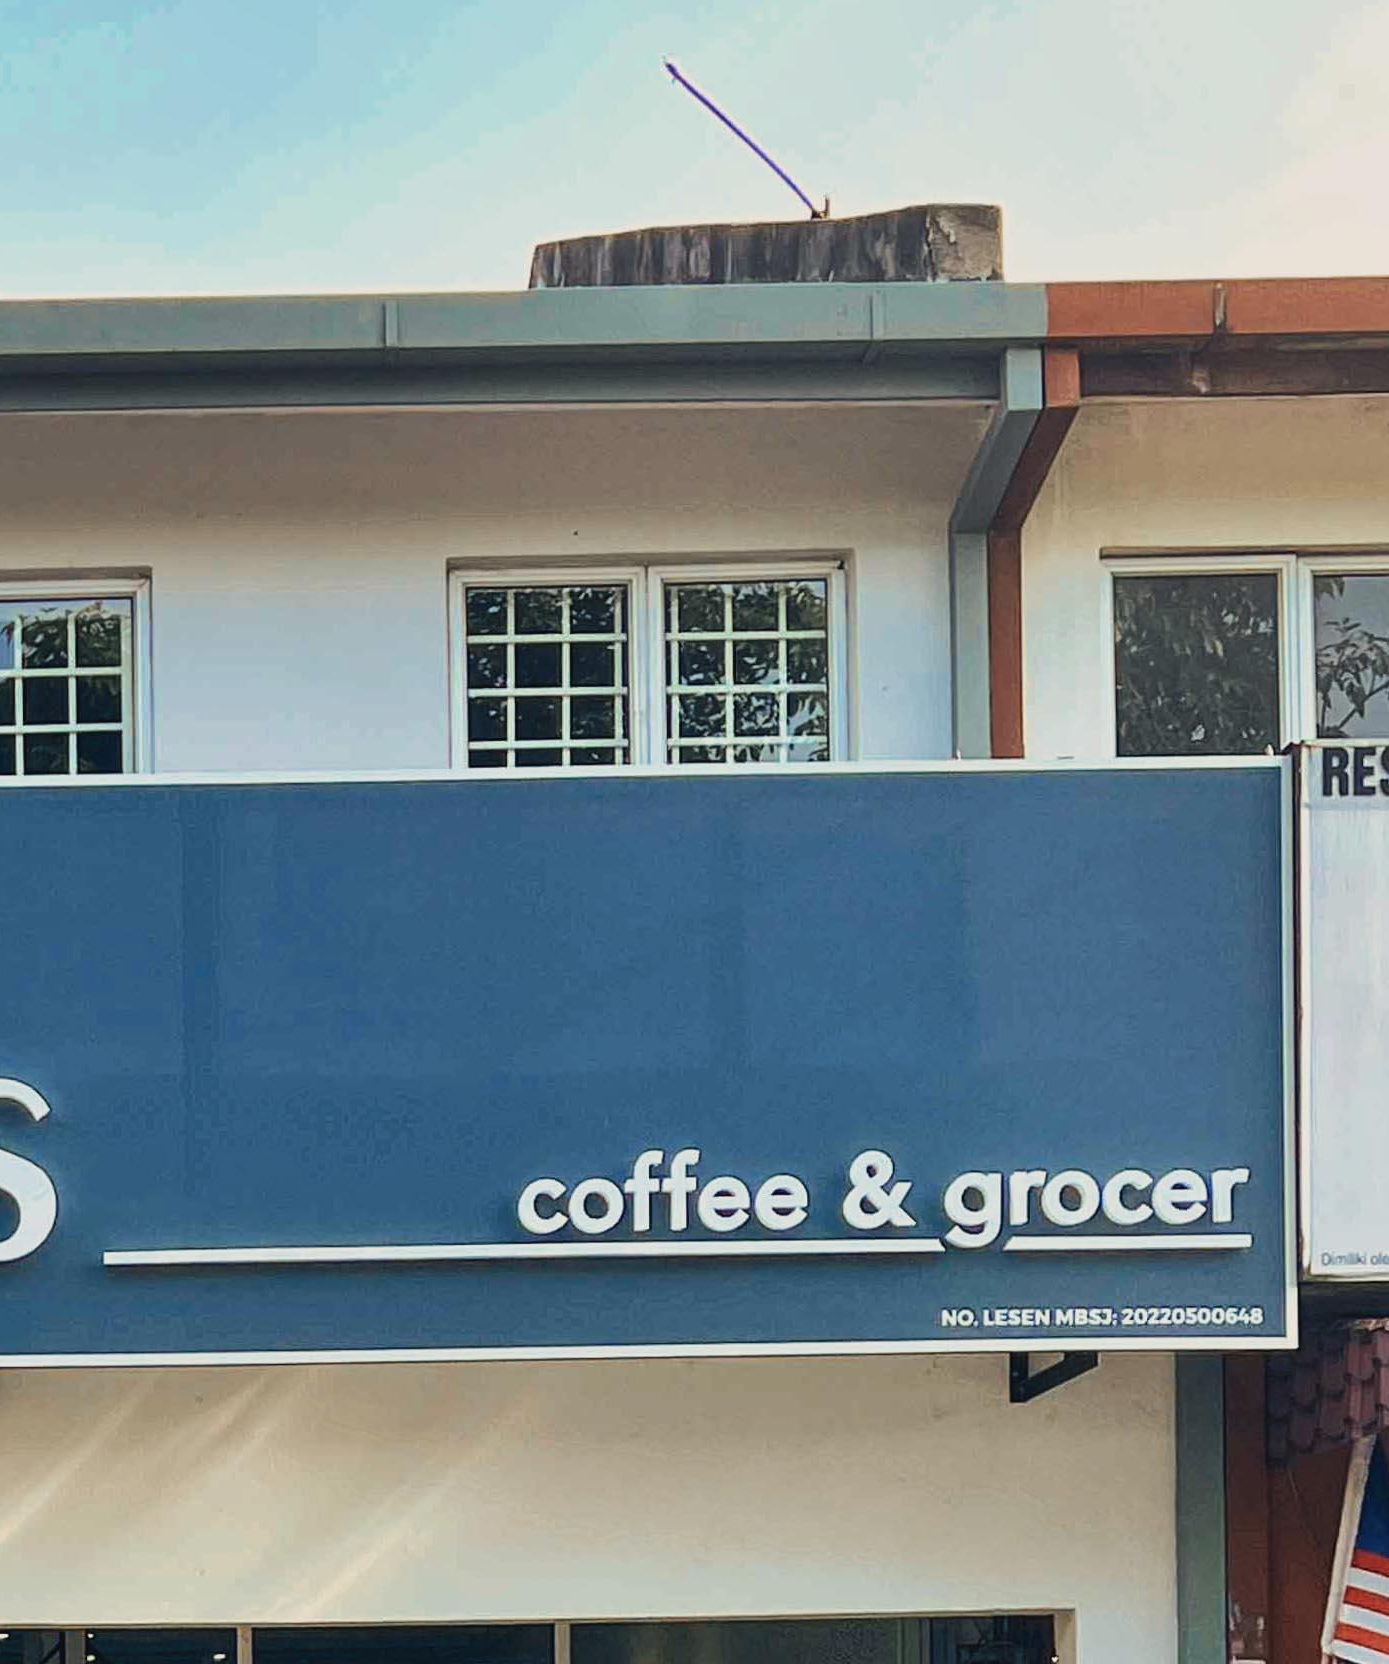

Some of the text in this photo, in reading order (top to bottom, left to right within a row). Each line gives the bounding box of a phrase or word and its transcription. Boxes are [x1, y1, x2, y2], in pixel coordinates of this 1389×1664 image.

[516, 1149, 1251, 1248] coffee & grocer
[940, 1307, 1265, 1328] NO. LESEN MBSJ: 20220500648
